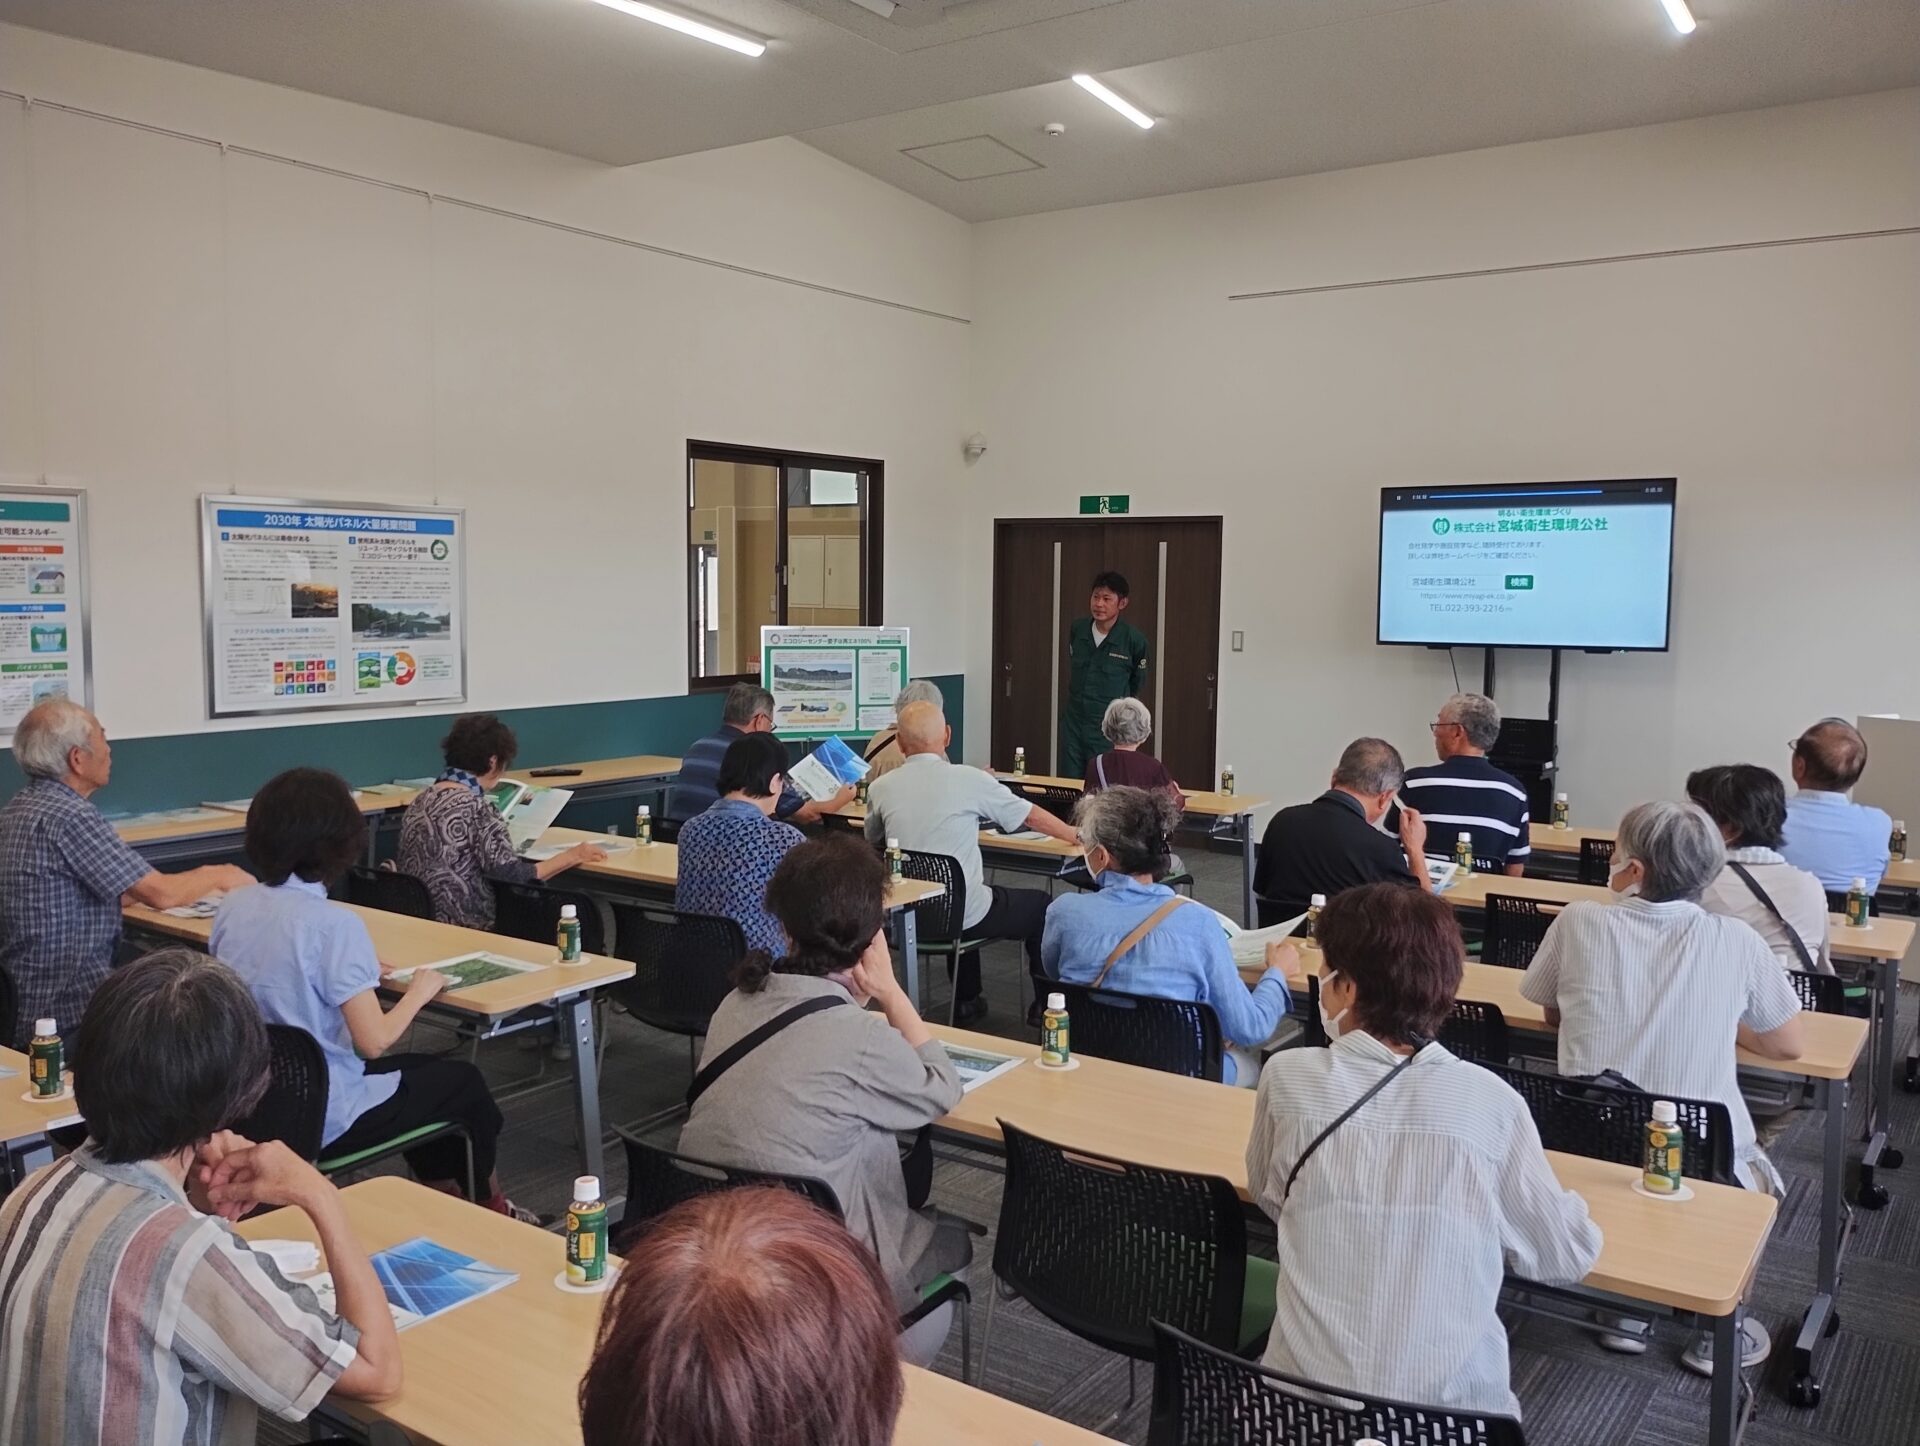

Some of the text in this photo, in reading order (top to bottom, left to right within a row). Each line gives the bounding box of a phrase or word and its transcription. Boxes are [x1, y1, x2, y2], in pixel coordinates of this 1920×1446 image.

[263, 513, 302, 527] 2030年
[1453, 517, 1608, 533] 株式会社 宮城衛生環境公社
[1411, 577, 1476, 587] 宮城衛生環境公社
